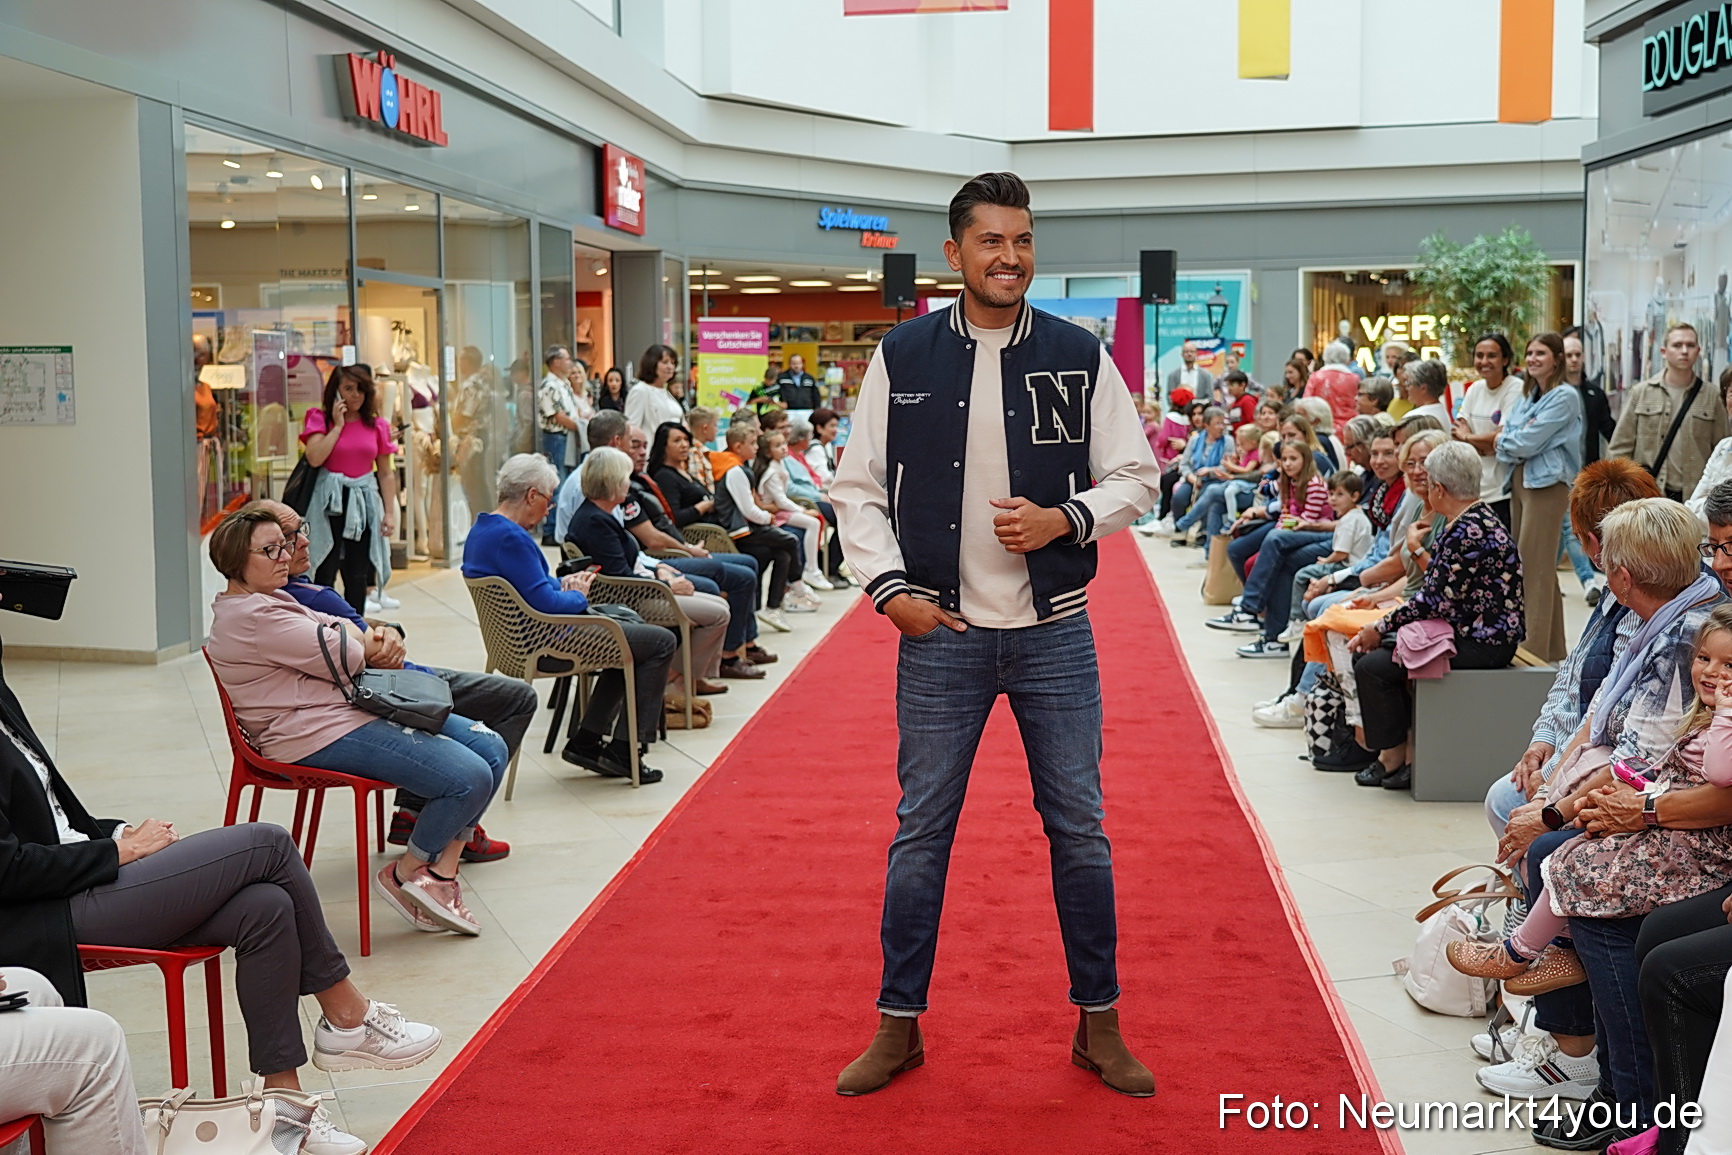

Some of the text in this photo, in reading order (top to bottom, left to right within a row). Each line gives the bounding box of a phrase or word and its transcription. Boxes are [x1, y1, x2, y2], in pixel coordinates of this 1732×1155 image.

[1641, 2, 1732, 93] DOUGLA
[348, 49, 448, 148] WÖHRL
[818, 207, 888, 230] Spielwaren
[1360, 315, 1466, 342] VER
[1025, 371, 1089, 444] N
